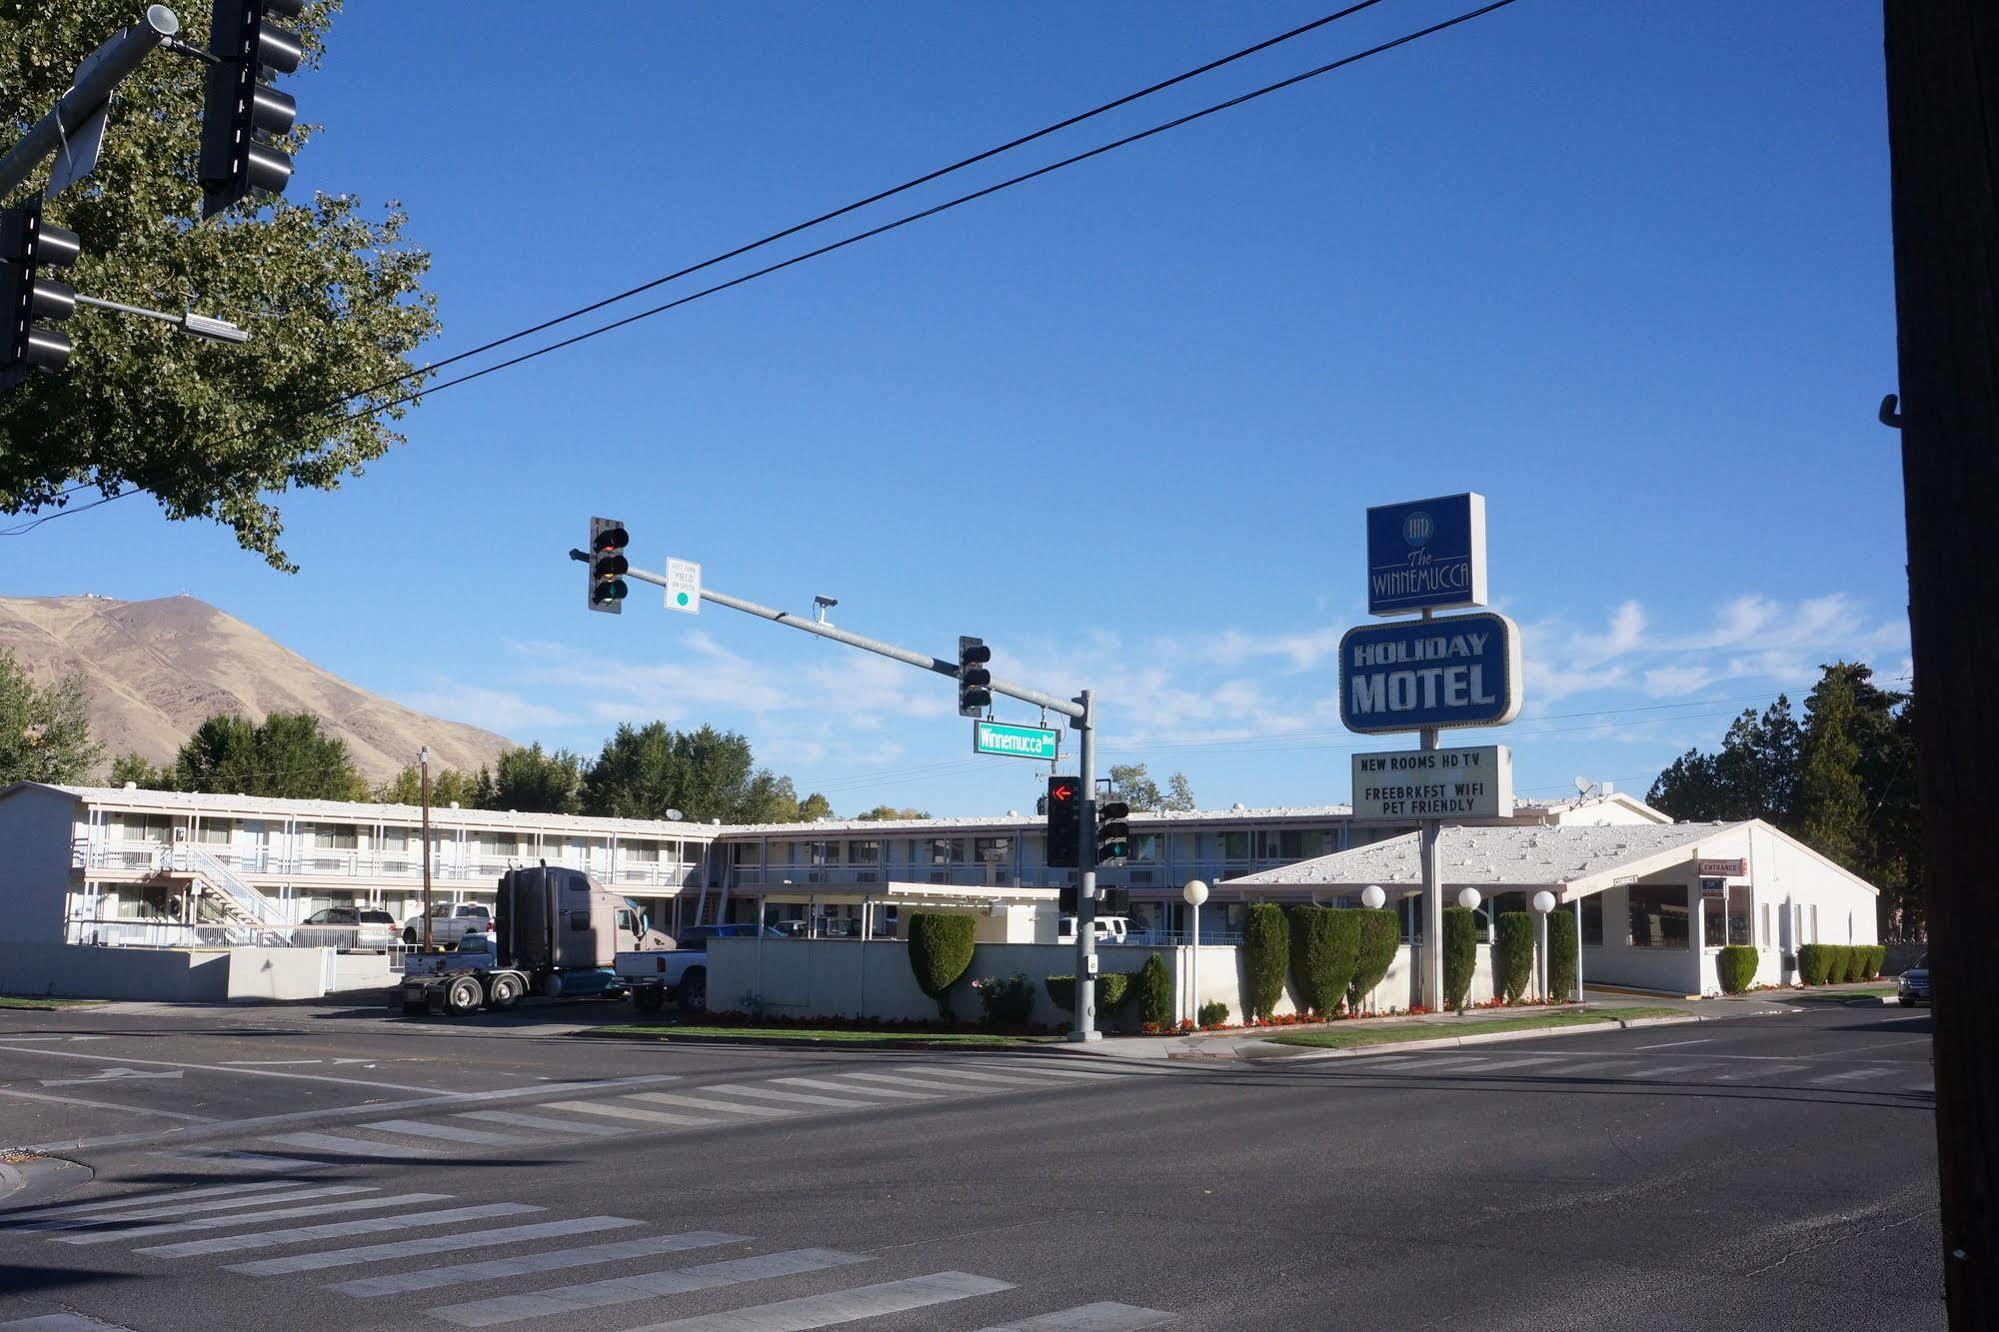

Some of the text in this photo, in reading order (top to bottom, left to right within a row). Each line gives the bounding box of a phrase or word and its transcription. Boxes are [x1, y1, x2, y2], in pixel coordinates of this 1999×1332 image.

[1407, 547, 1432, 568] The
[1373, 562, 1470, 597] WINNEMUCCA
[1354, 632, 1489, 667] HOLIDAY
[1352, 664, 1495, 715] MOTEL
[981, 727, 1042, 753] Winnemucca
[1361, 753, 1480, 771] NEW ROOMS HD TV
[1455, 783, 1484, 797] WIFI
[1383, 798, 1474, 815] PET FRIENDLY
